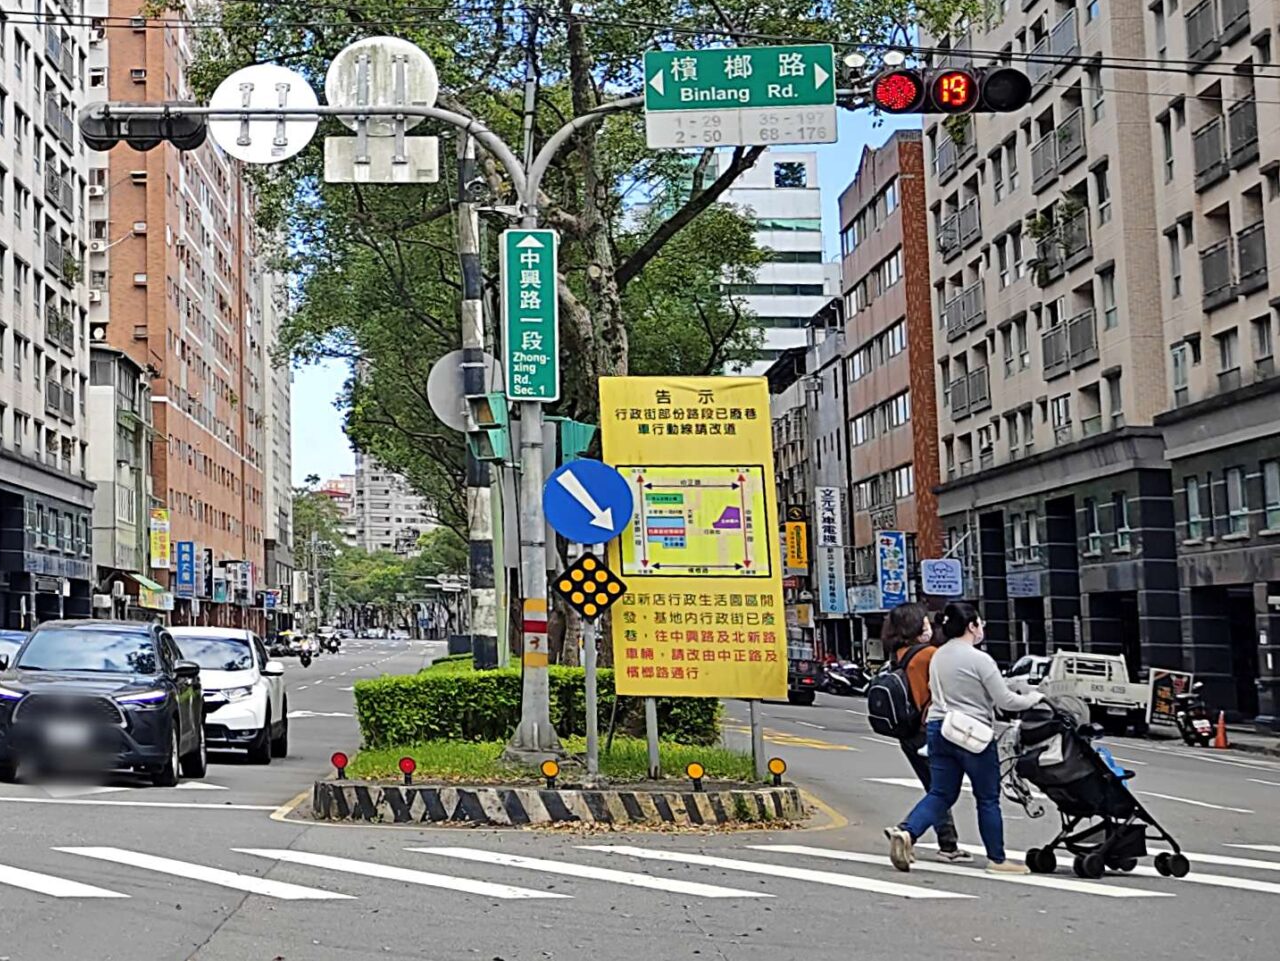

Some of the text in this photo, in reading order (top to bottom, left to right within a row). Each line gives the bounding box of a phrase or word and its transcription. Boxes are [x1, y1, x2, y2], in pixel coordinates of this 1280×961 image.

[680, 83, 799, 103] Binlang Rd.
[519, 249, 544, 351] 中興路一段
[512, 352, 551, 364] Zhong-
[513, 364, 537, 374] xing
[513, 374, 532, 385] Rd.
[513, 385, 537, 395] Sec.
